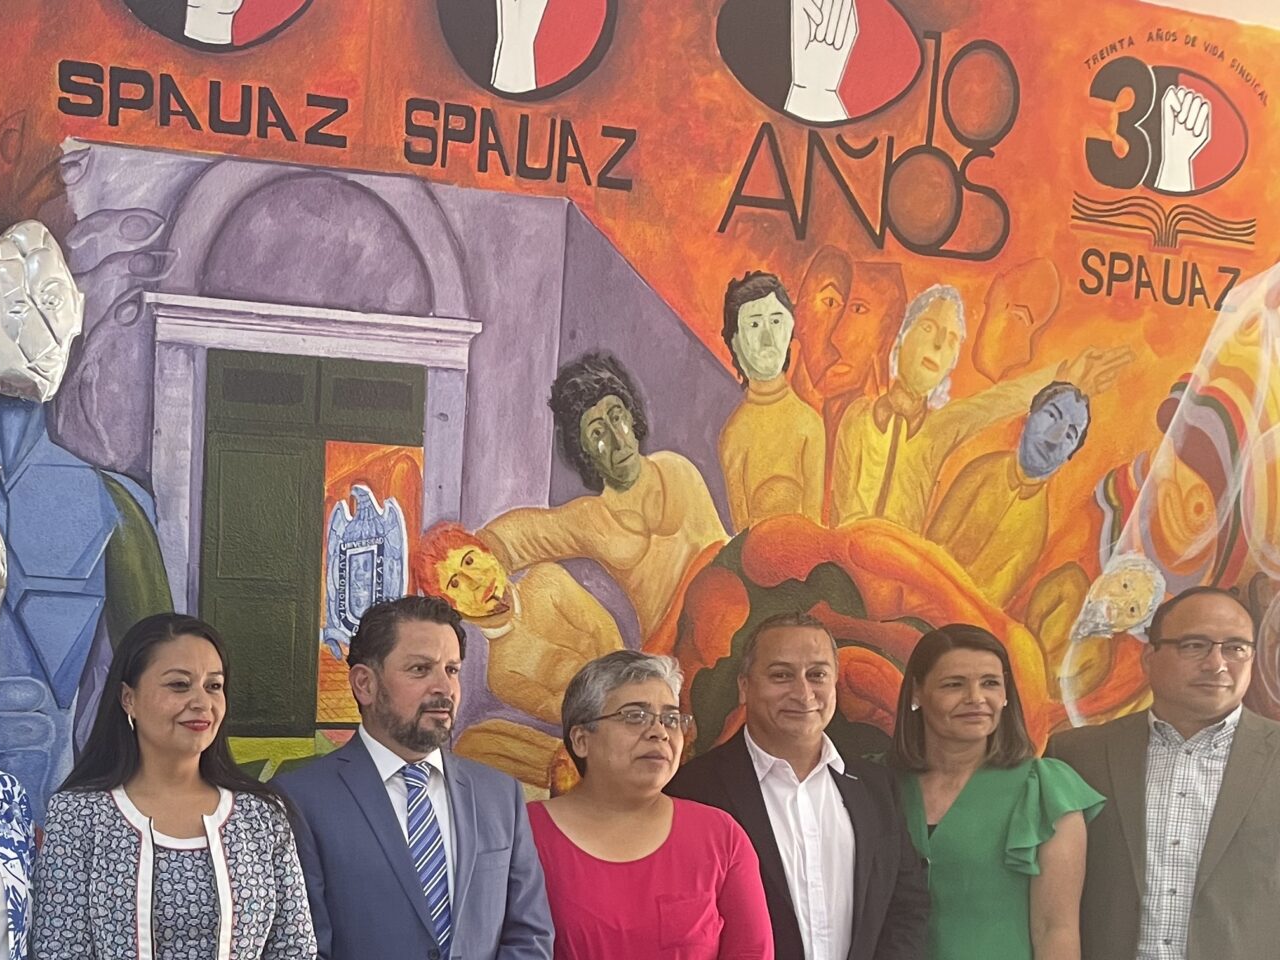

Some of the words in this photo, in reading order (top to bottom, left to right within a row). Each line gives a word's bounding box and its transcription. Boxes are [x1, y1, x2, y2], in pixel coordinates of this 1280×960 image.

[57, 59, 348, 148] SPAUAZ
[923, 31, 1020, 150] 10
[1084, 36, 1134, 69] TREINTA
[1147, 28, 1177, 42] AÑOS
[1184, 34, 1197, 47] DE
[1204, 42, 1225, 61] VIDA
[1231, 57, 1269, 106] SINDICAL
[404, 98, 637, 191] SPAUAZ
[717, 122, 1010, 261] AÑOS
[1079, 248, 1241, 311] SPAUAZ
